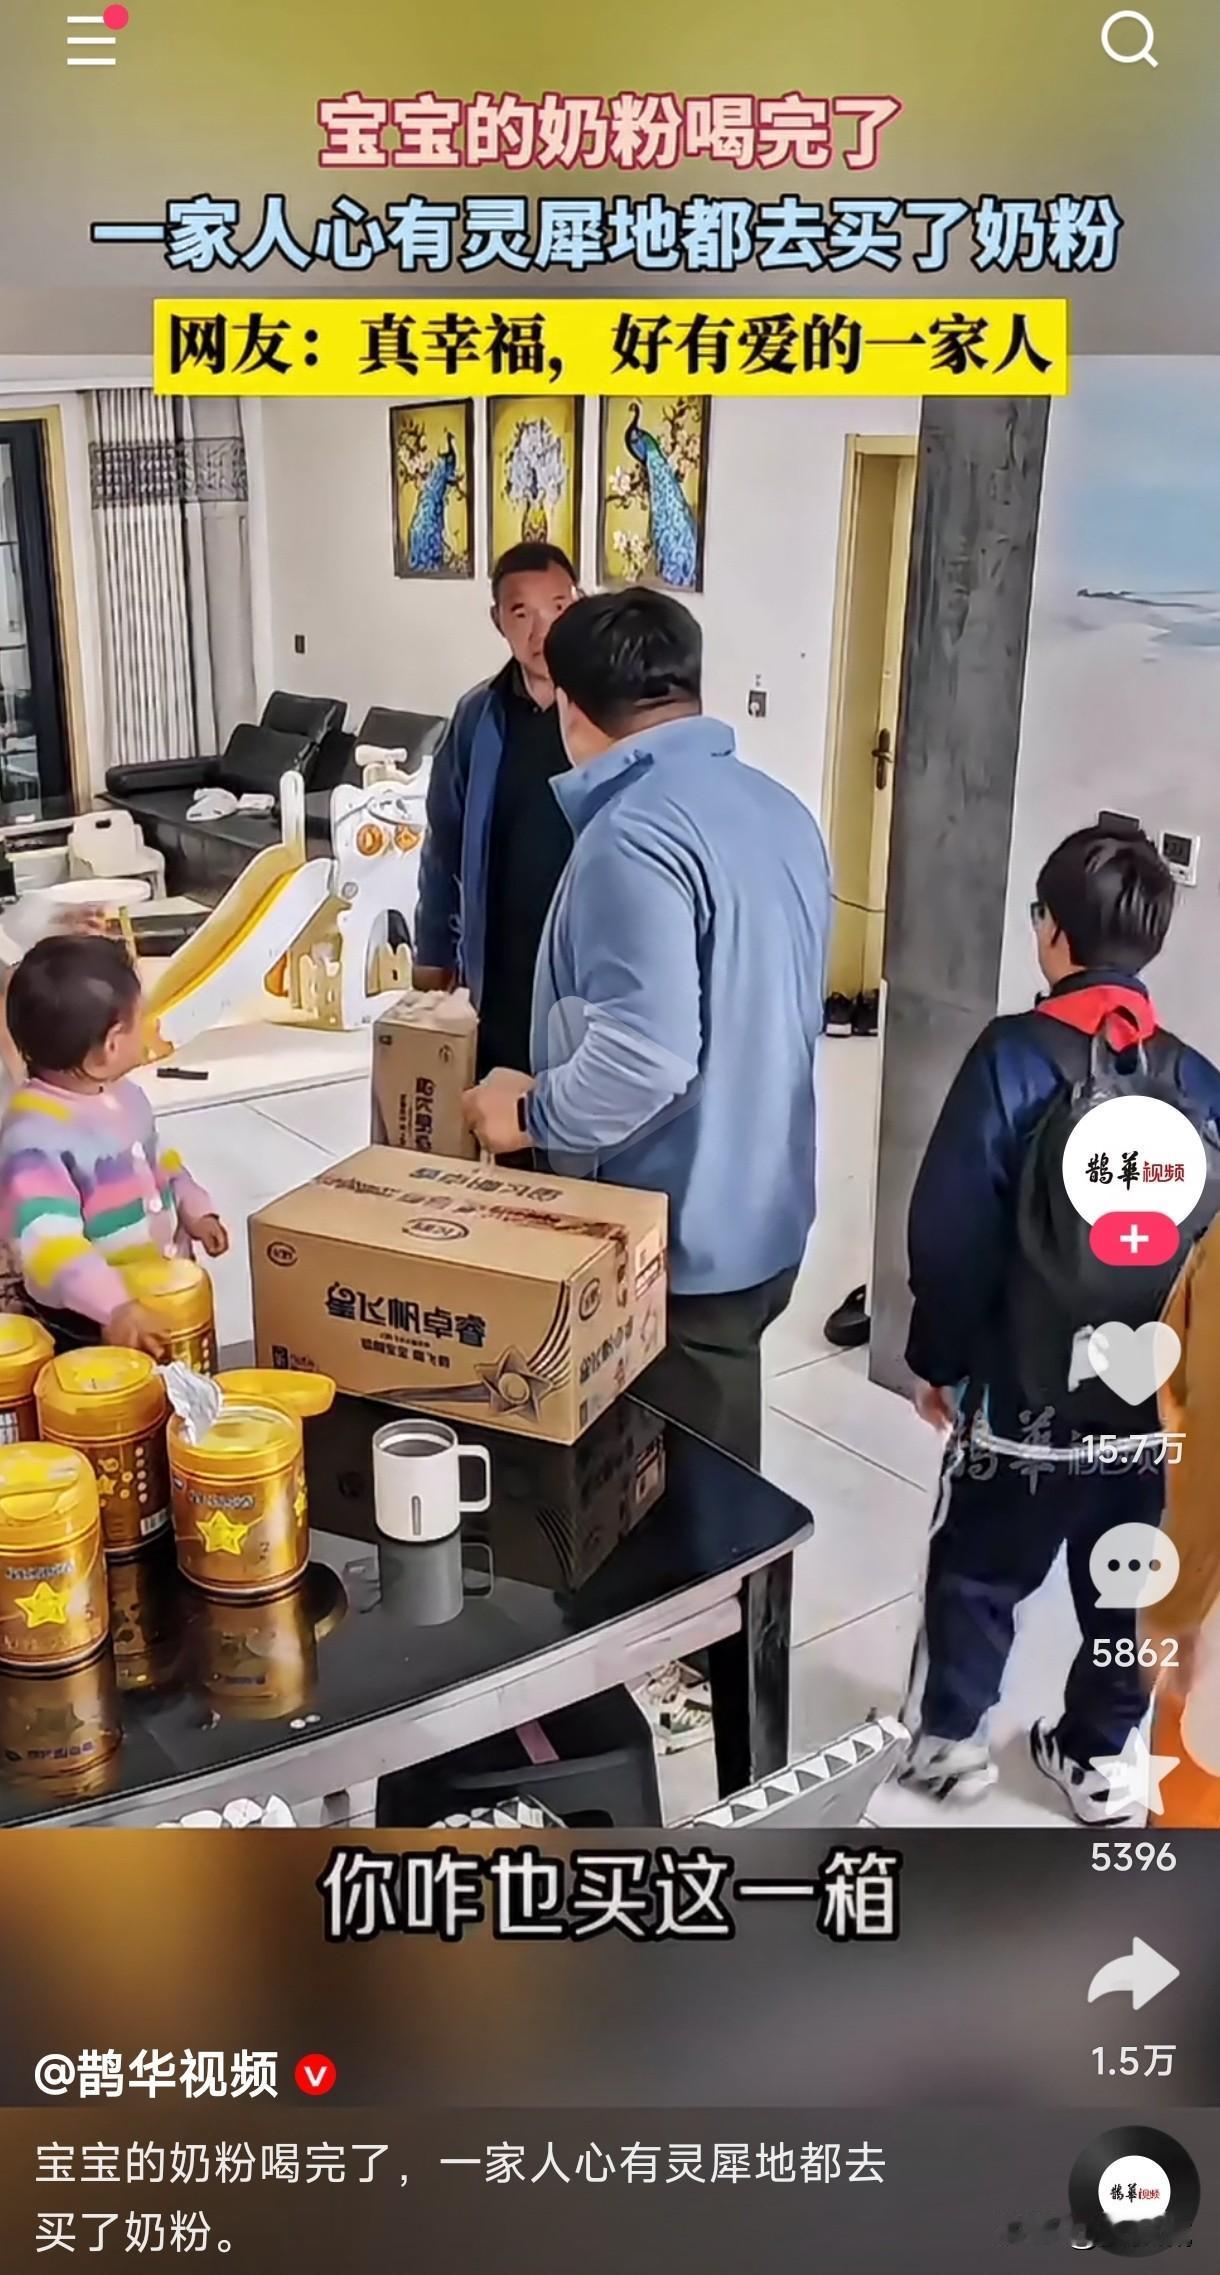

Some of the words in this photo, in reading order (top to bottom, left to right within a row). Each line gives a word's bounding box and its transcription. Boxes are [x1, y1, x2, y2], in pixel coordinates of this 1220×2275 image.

[325, 1281, 486, 1347] 星飞帆卓睿
